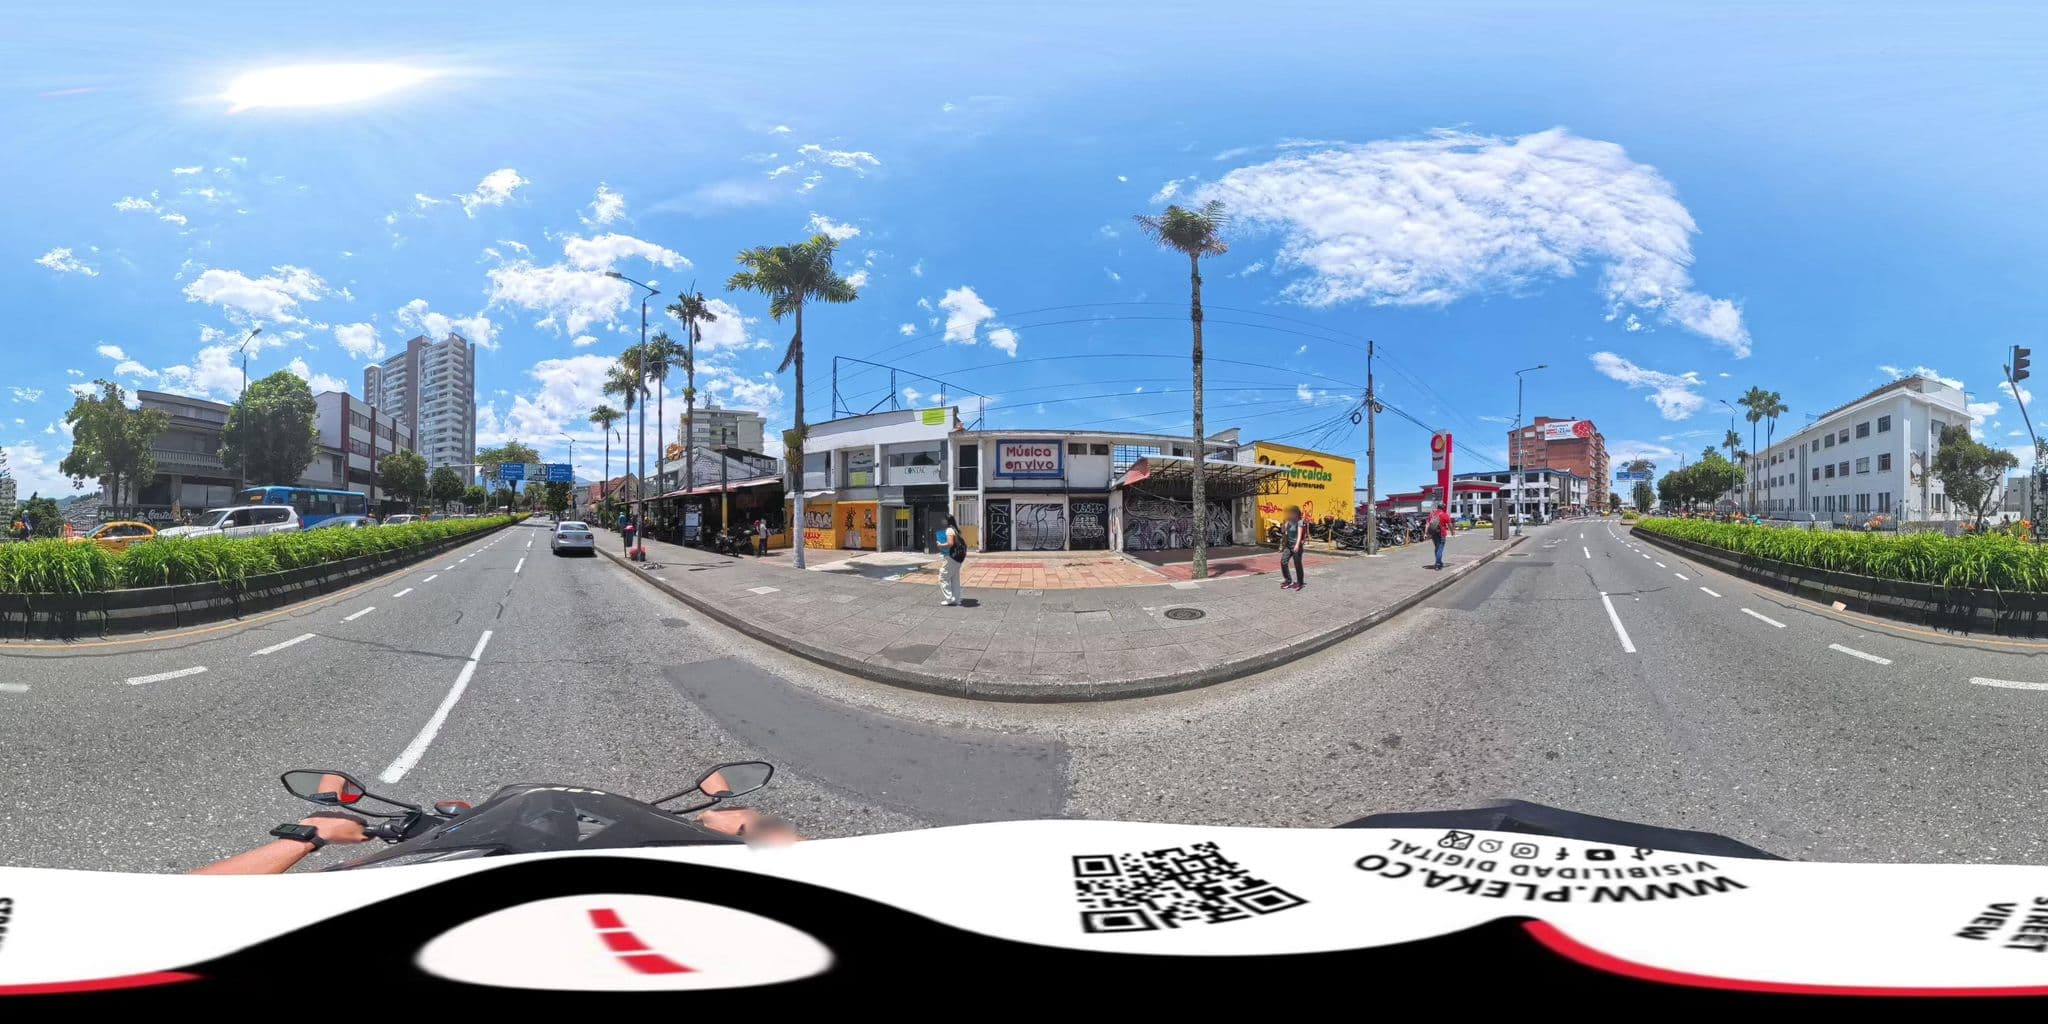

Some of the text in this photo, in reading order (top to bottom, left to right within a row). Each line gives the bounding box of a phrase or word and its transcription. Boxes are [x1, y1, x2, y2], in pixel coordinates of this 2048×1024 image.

[1006, 444, 1052, 457] Música
[1005, 459, 1054, 471] en vivo
